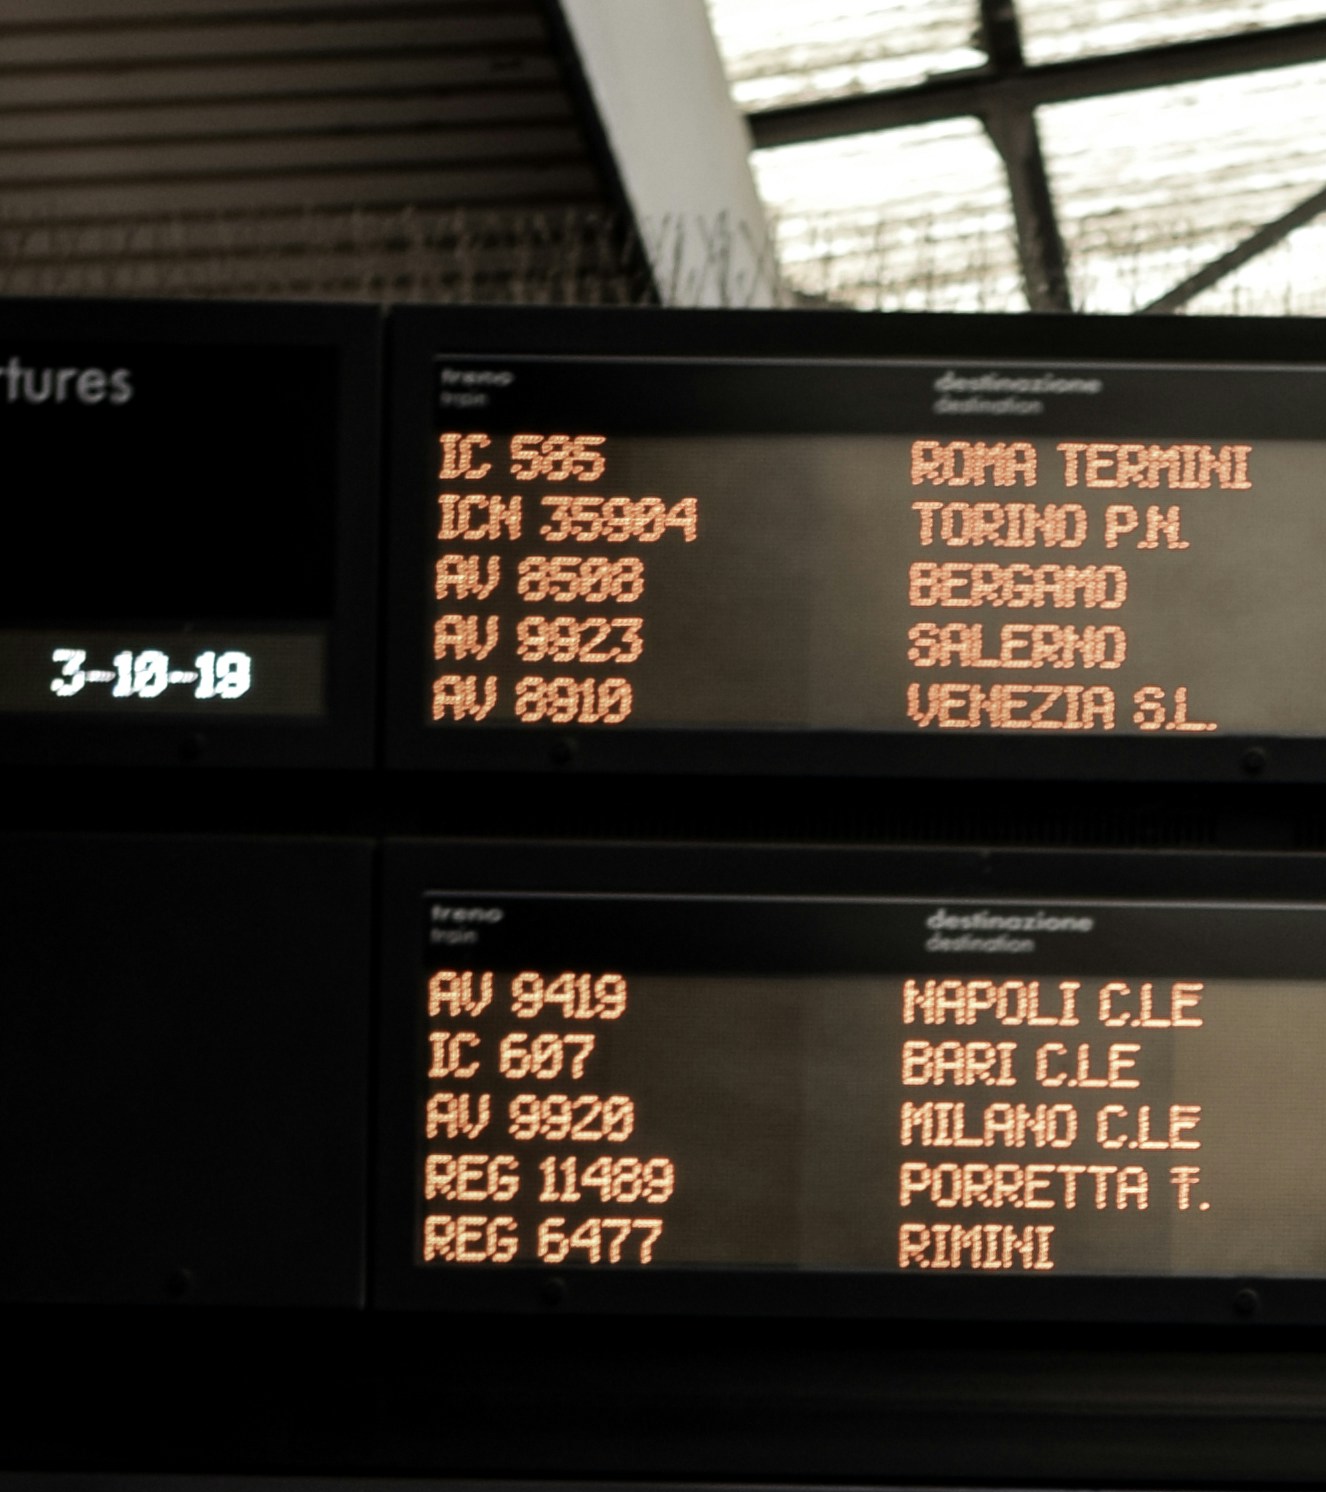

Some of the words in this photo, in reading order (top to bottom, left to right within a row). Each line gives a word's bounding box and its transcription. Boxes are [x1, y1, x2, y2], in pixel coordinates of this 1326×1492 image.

[440, 434, 492, 480] IC
[912, 441, 1038, 488] ROMA
[1058, 444, 1253, 491] TERMINI
[439, 495, 523, 541] ICN
[913, 502, 1089, 549] TORINO
[437, 555, 501, 601] AV
[910, 563, 1129, 610] BERGAMO
[435, 615, 499, 662] AV
[909, 623, 1128, 670] SALERNO
[434, 676, 498, 722] AV
[908, 684, 1116, 731] VENEZIA
[430, 972, 494, 1018] AV
[512, 973, 628, 1020] 9419
[904, 980, 1082, 1028] NAPOLI
[430, 1033, 481, 1079] IC
[501, 1034, 596, 1080] 607
[903, 1041, 1018, 1087] BARI
[427, 1094, 491, 1140] AV
[510, 1095, 635, 1143] 9920
[901, 1102, 1079, 1149] MILANO
[426, 1155, 520, 1202] REG
[540, 1157, 675, 1204] 11489
[900, 1163, 1150, 1211] PORRETTA
[425, 1216, 519, 1263] REG
[539, 1218, 664, 1265] 6477
[900, 1224, 1056, 1271] RIMINI
